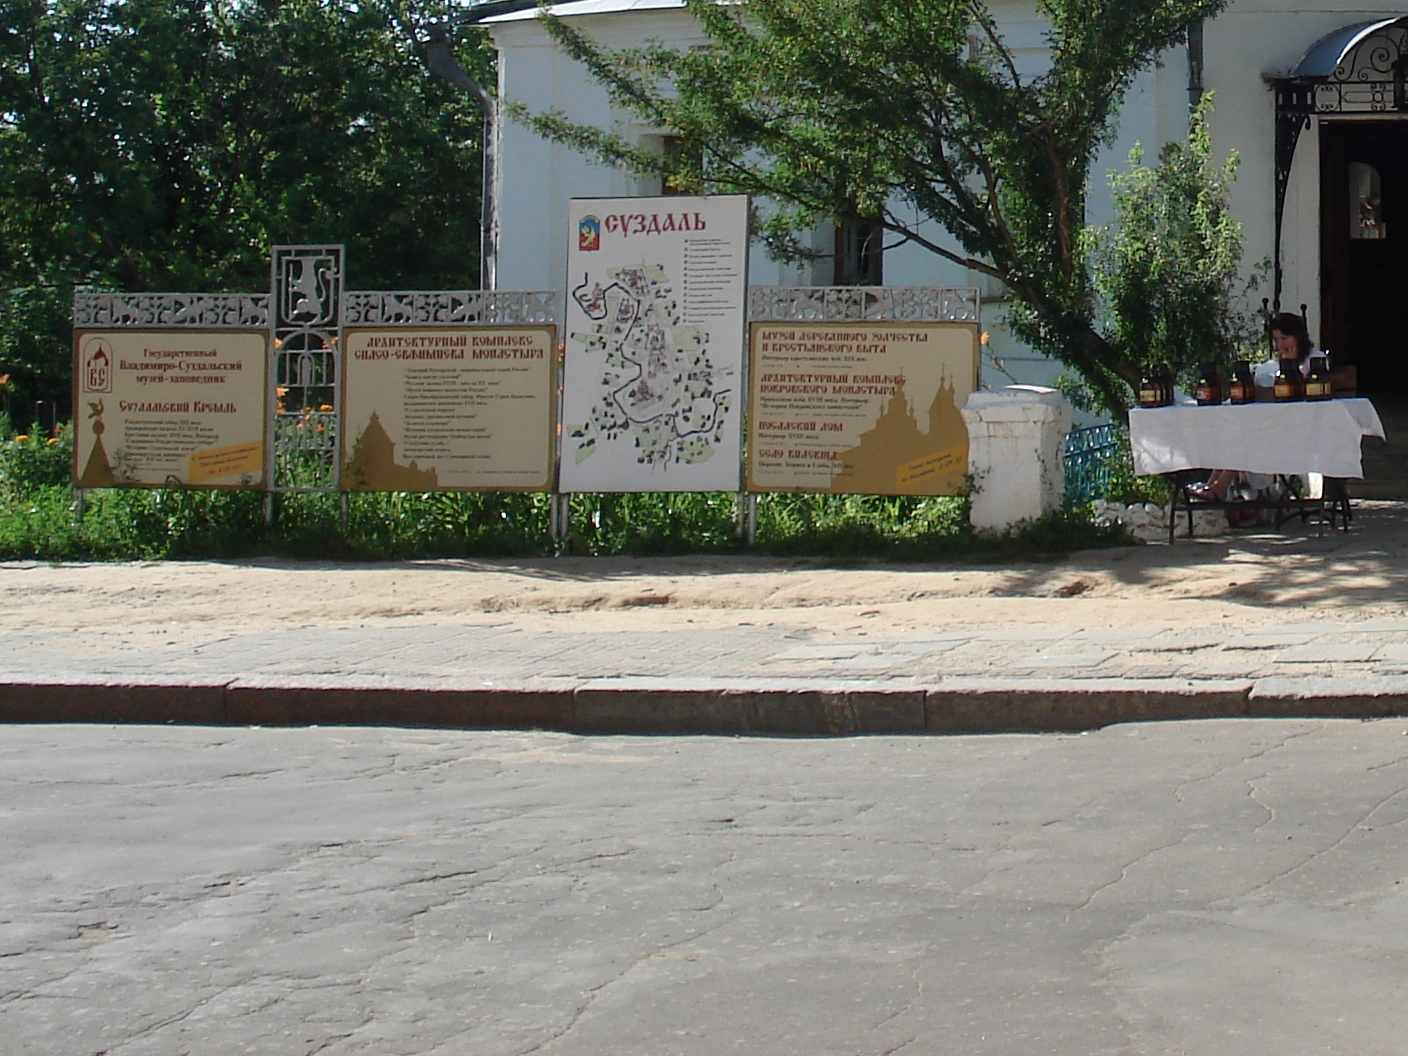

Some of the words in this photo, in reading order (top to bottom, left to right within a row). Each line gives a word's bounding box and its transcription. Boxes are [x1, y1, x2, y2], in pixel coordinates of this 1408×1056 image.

[604, 212, 707, 238] СУЗДАЛЬ
[367, 336, 467, 347] АРХИТЕКТУРНЫЙ
[472, 335, 533, 347] КОМПЛЕКС
[762, 331, 795, 341] МУЗЕЙ
[143, 348, 217, 358] Государственный
[472, 348, 544, 359] МОНАСТЫРЯ
[856, 344, 886, 353] БЫТА
[760, 374, 848, 384] АРХИТЕКТУРНЫЙ
[820, 422, 843, 432] ДОМ
[759, 449, 784, 458] СЕЛО
